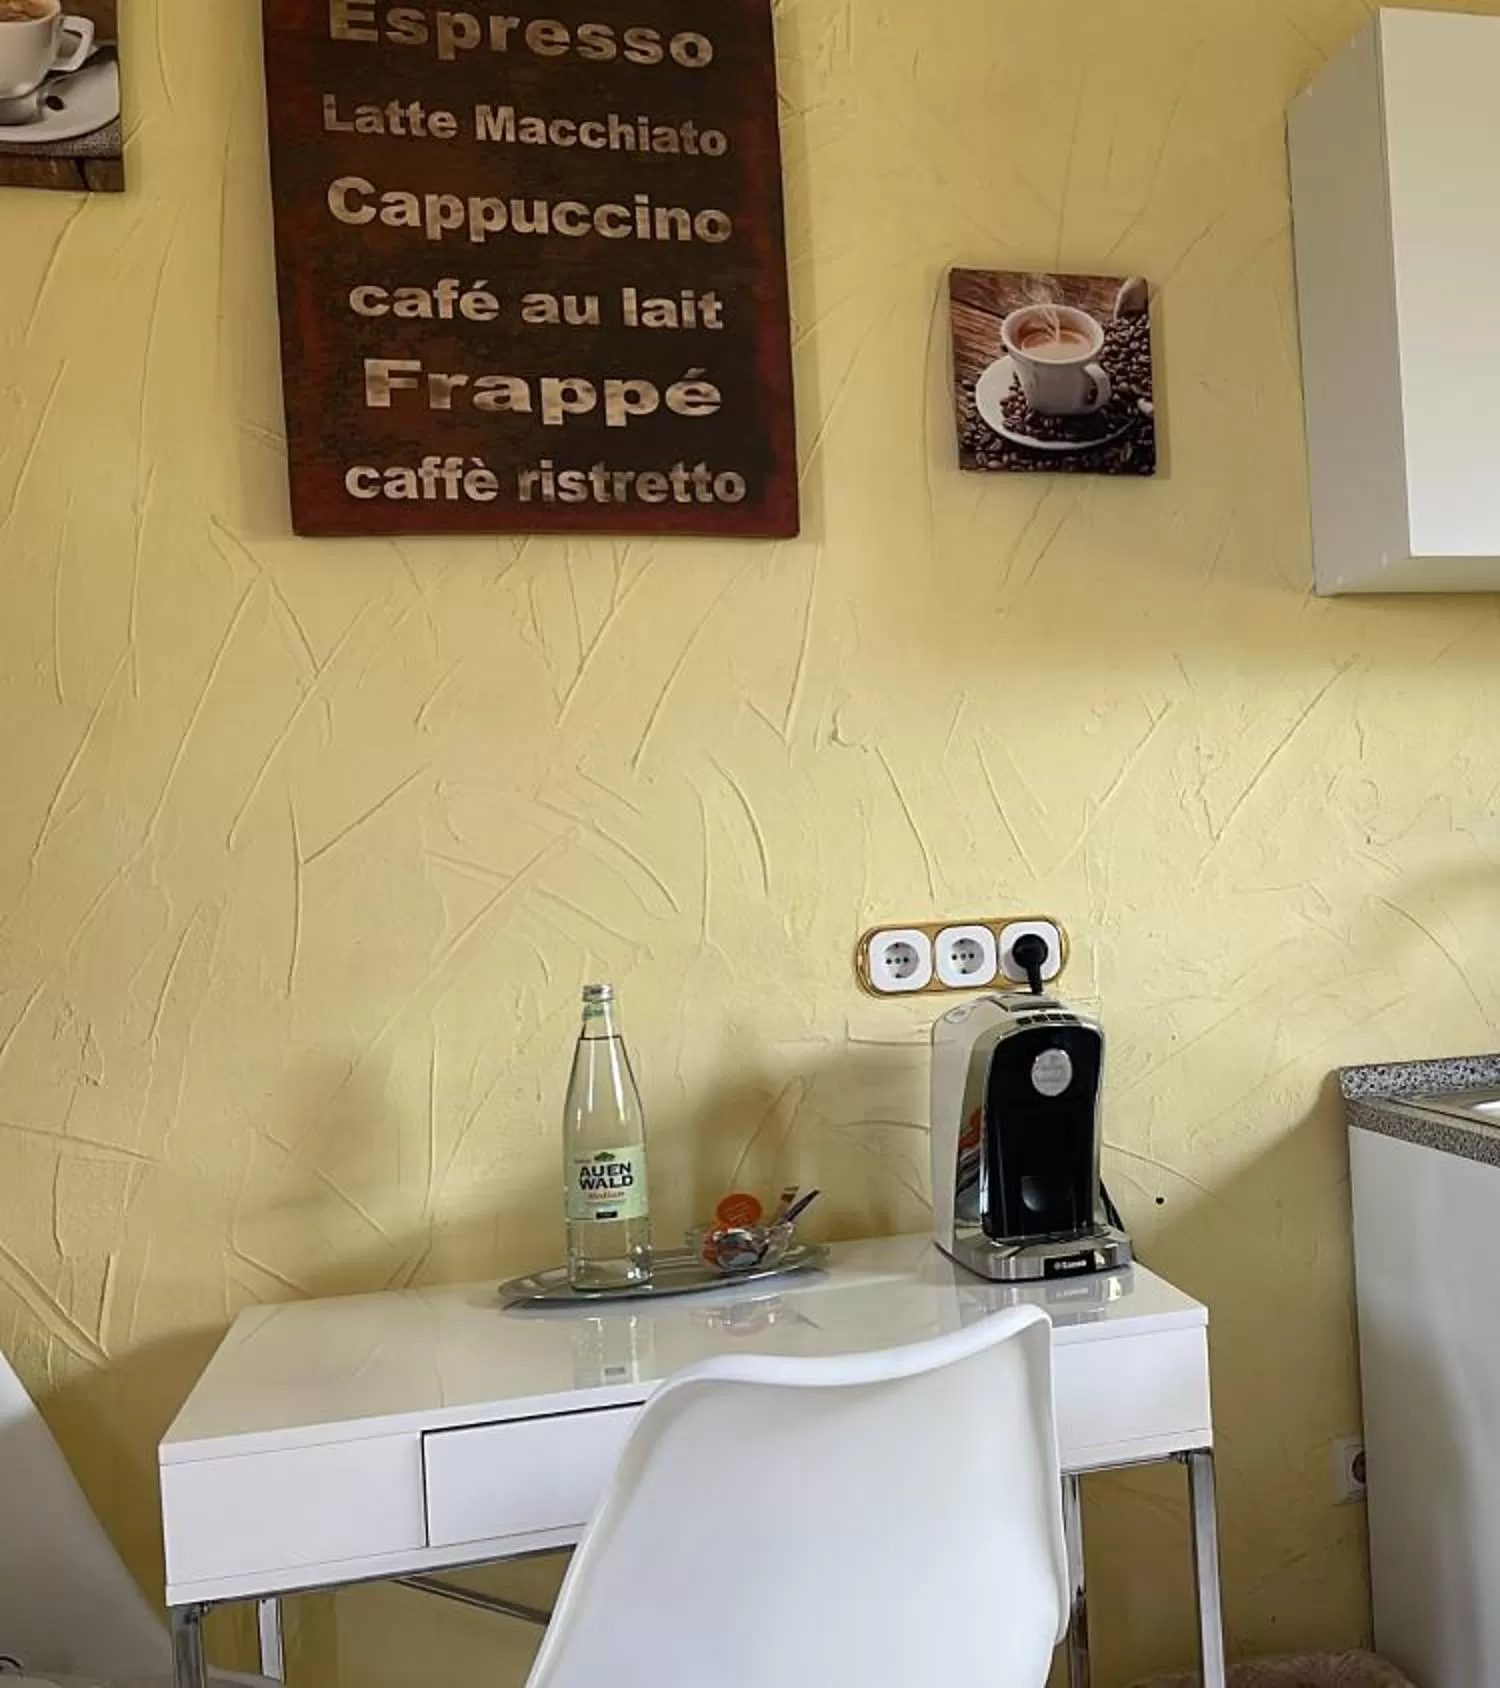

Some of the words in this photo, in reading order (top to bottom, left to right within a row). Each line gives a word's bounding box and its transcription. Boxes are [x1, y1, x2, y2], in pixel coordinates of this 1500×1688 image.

[329, 0, 714, 68] Espresso
[323, 94, 458, 139] Latte
[474, 103, 729, 157] Macchiato
[327, 176, 733, 243] Cappuccino
[349, 280, 500, 322] café
[522, 292, 600, 325] au
[622, 287, 723, 330] lait
[363, 358, 722, 427] Frappé
[345, 456, 499, 501] caffè
[517, 459, 747, 504] ristretto
[579, 1161, 631, 1178] AUEN
[579, 1175, 634, 1190] WALD
